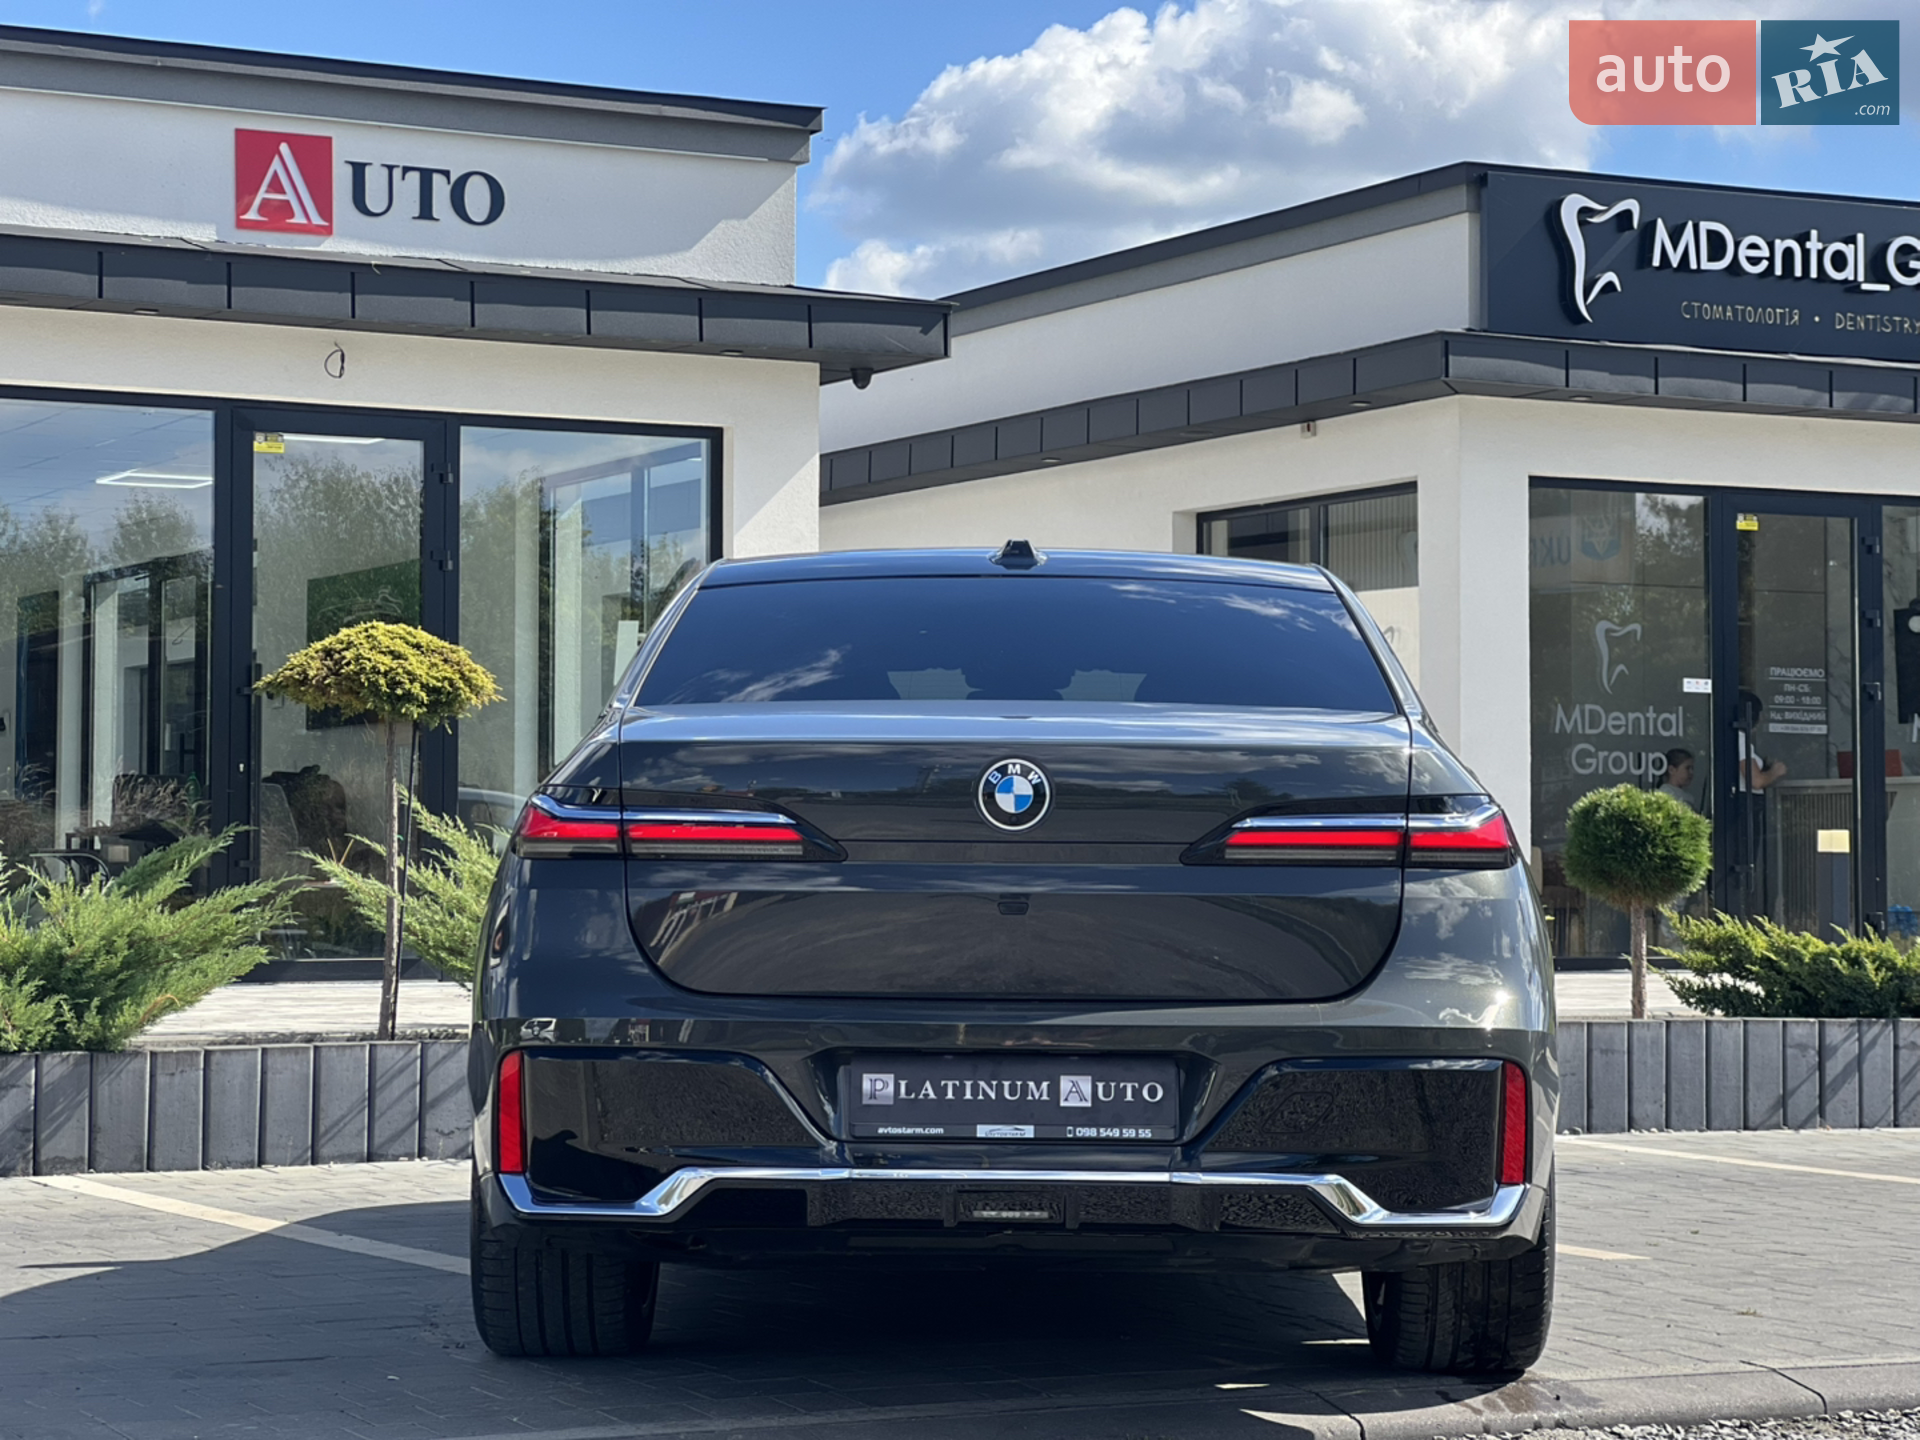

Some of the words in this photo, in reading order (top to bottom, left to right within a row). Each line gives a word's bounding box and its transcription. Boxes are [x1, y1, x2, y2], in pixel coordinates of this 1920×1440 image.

[1554, 703, 1684, 737] MDental
[988, 763, 1041, 785] BMW
[1571, 743, 1668, 783] Group
[866, 1077, 1051, 1101] PLATINUM
[1062, 1078, 1164, 1103] AUTO
[877, 1126, 944, 1135] avtostarm.com
[1075, 1127, 1097, 1137] 098
[1099, 1127, 1120, 1138] 549
[1122, 1128, 1136, 1138] 59
[1138, 1128, 1153, 1139] 55
